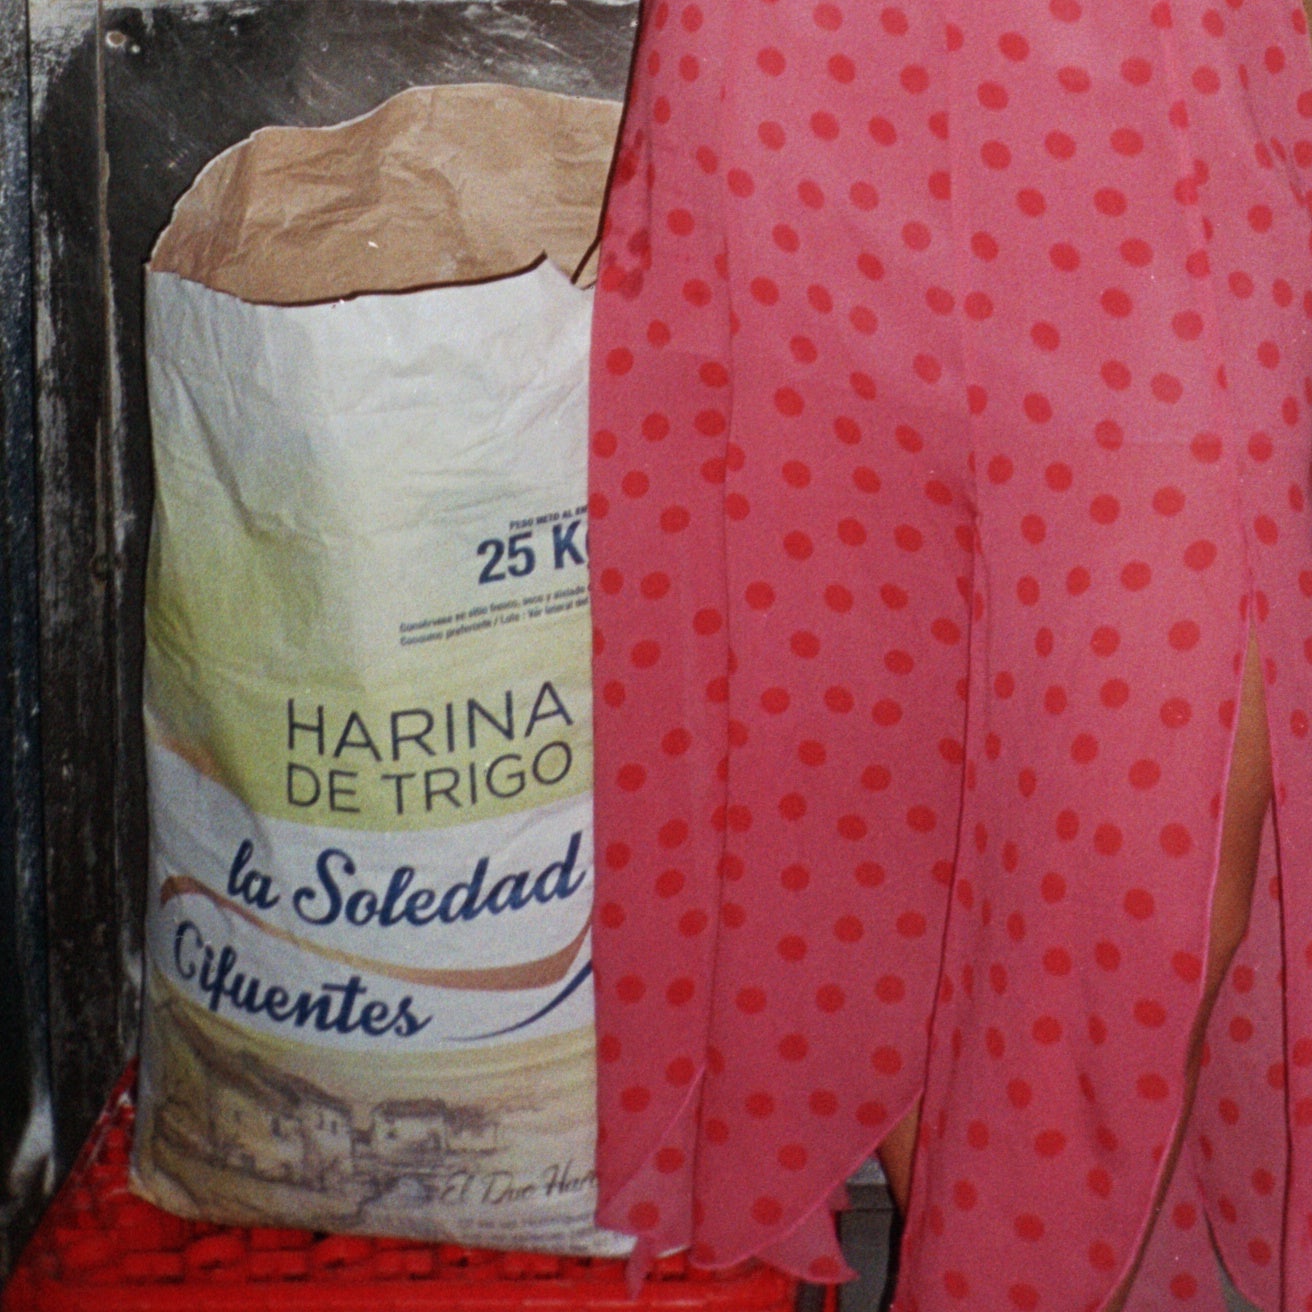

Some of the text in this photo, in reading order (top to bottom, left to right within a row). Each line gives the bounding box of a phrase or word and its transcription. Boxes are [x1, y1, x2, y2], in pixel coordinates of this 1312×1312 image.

[477, 520, 590, 585] 25 K
[287, 681, 574, 762] HARINA
[287, 740, 573, 815] DE TRIGO
[226, 831, 587, 927] la Soledad
[173, 920, 433, 1038] Cifuentes
